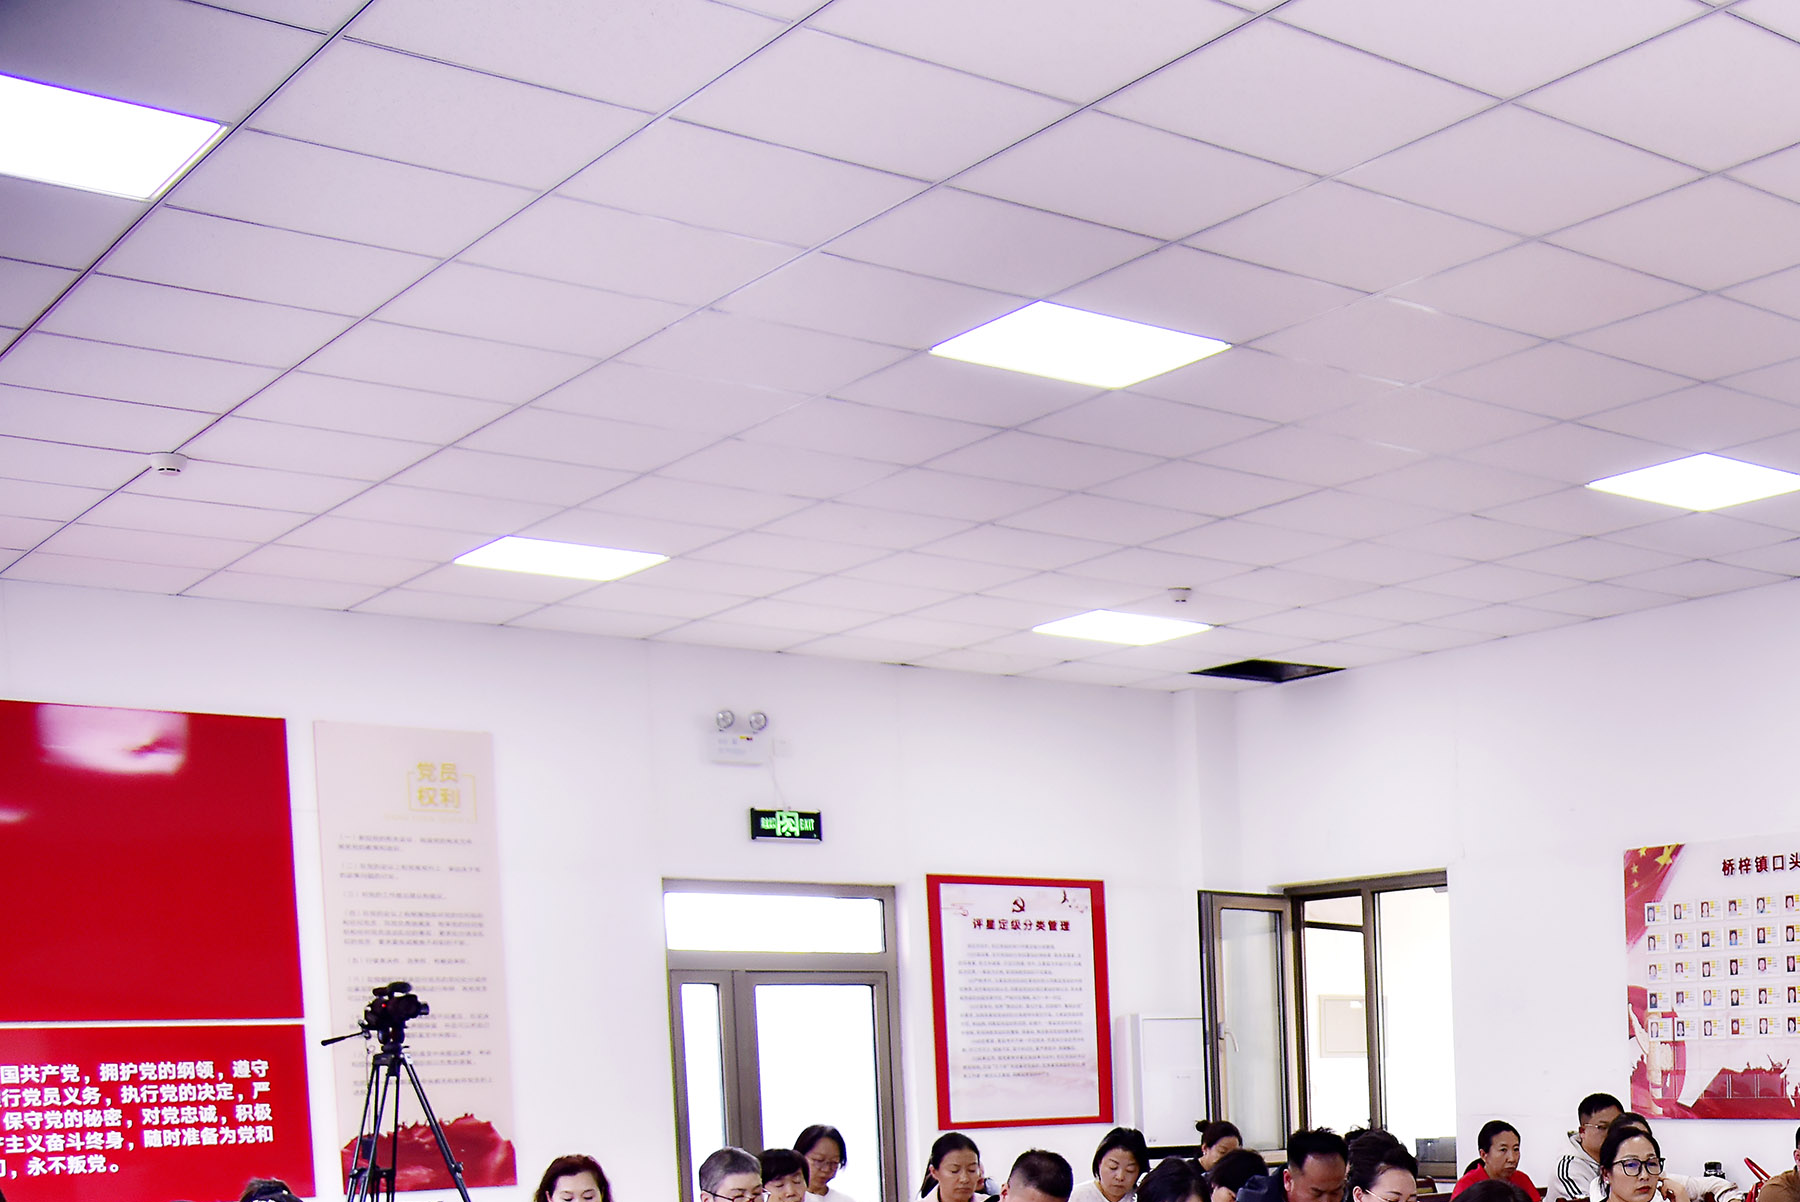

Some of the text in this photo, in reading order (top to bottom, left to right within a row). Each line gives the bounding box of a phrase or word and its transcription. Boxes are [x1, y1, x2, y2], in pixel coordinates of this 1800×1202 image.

[416, 761, 458, 783] 党员
[417, 786, 461, 809] 权利
[800, 818, 815, 832] EXIT
[972, 918, 1071, 932] 评星定级分类管理
[0, 1081, 271, 1108] 行党员义务，执行党的决定，严
[0, 1125, 274, 1154] 主义奋斗终身，随时准备为党和
